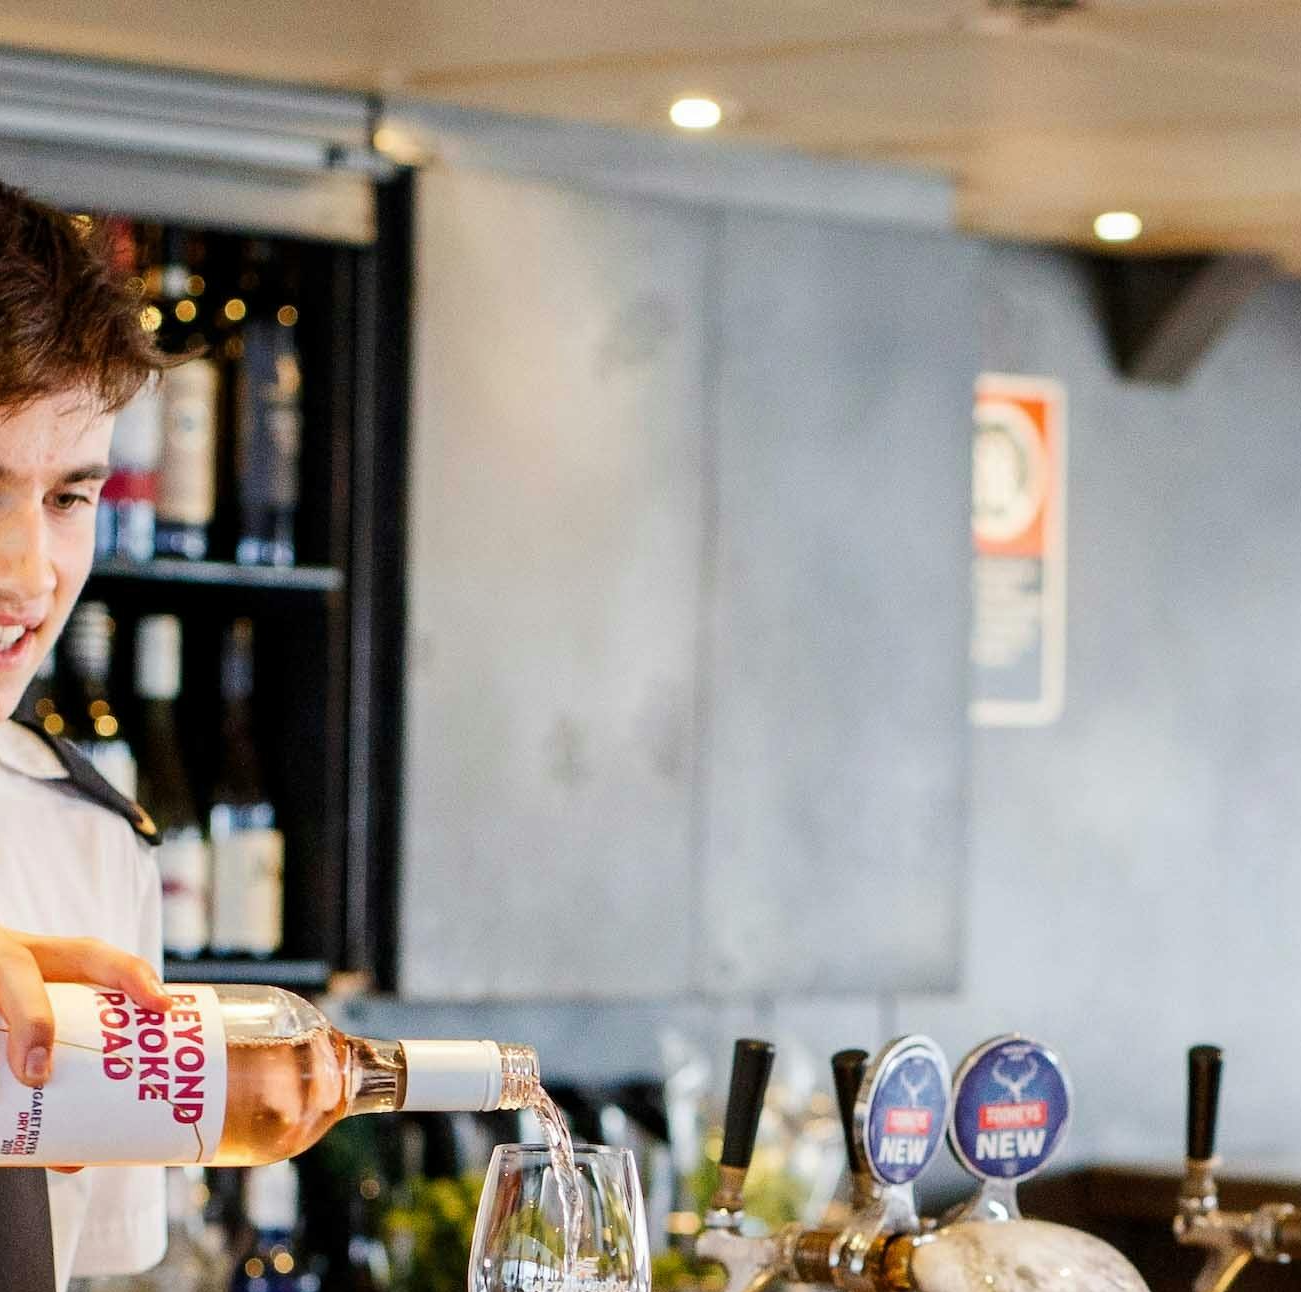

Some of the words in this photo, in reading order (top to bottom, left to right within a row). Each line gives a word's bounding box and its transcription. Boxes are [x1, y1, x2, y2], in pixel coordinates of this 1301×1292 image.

[95, 992, 133, 1081] ROAD
[134, 1007, 170, 1101] ROKE
[170, 994, 205, 1124] BEYOND
[16, 1112, 29, 1132] DRY
[30, 1084, 44, 1128] RGARET
[25, 1130, 40, 1155] RIVER
[878, 1135, 929, 1165] NEW
[975, 1128, 1046, 1161] NEW
